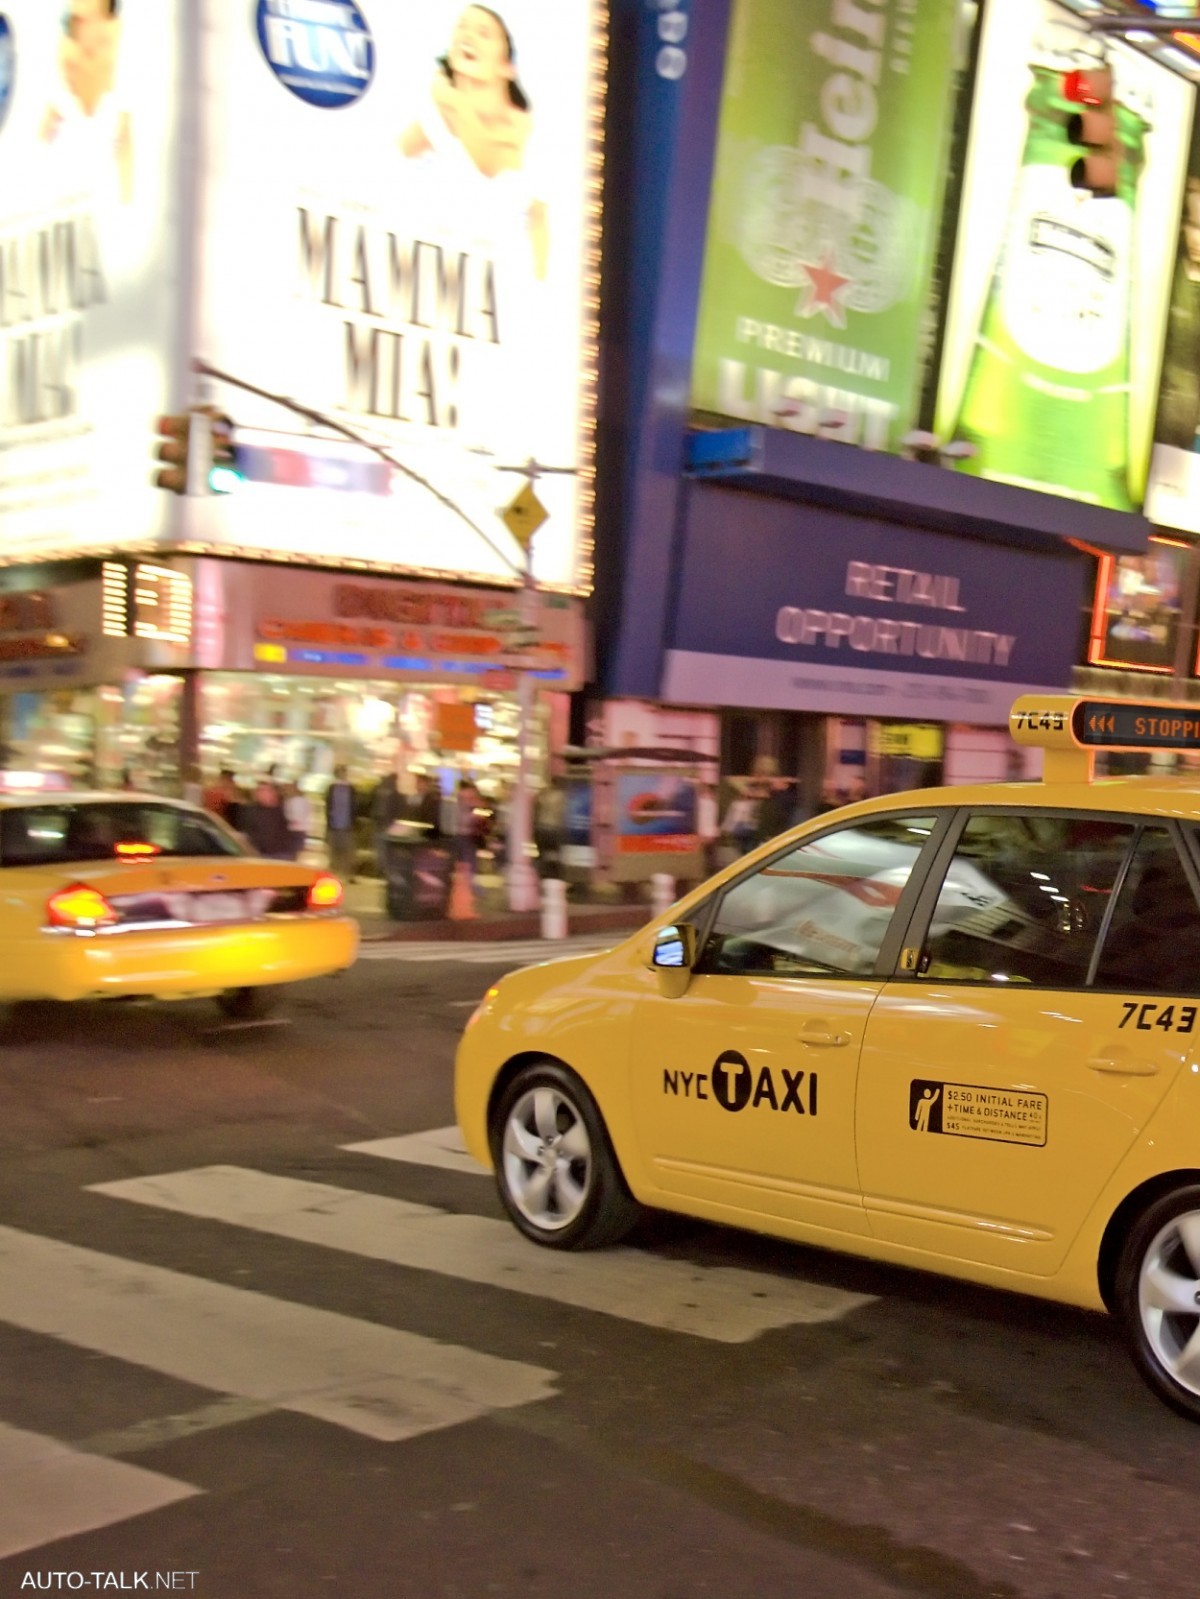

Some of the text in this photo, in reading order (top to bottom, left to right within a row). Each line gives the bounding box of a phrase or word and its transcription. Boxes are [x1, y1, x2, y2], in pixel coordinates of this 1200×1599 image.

[297, 206, 500, 344] MAMMA
[343, 320, 460, 427] MIA!
[735, 315, 891, 383] PREMIUM
[845, 560, 967, 612] RETAIL
[775, 605, 1018, 667] OPPORTUNITY
[1118, 1002, 1198, 1033] 7C43
[664, 1051, 818, 1116] NYC TAXI
[947, 1090, 1043, 1111] $2.50 INITIAL FARE
[984, 1107, 1028, 1121] DISTANCE
